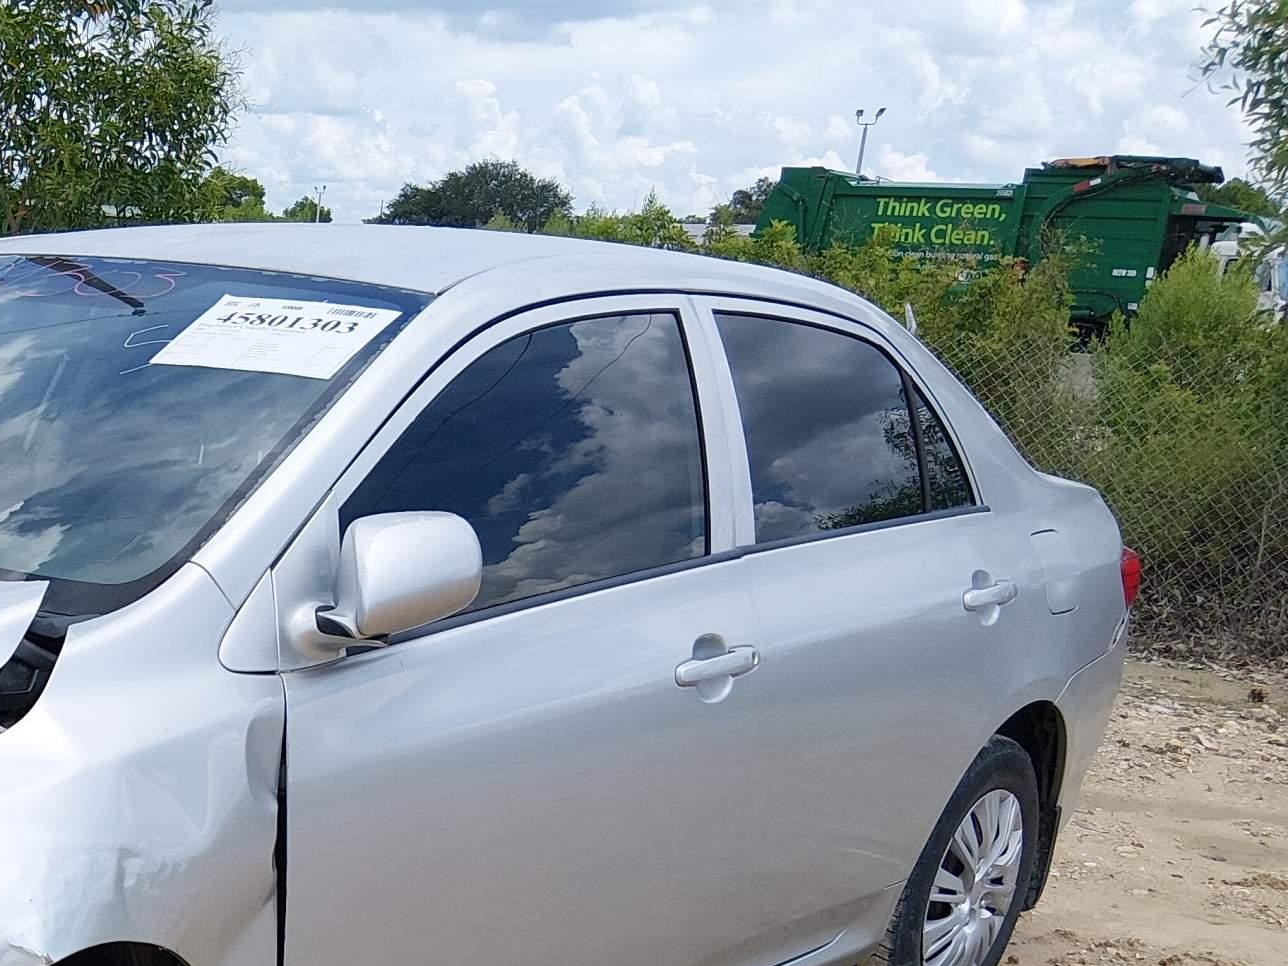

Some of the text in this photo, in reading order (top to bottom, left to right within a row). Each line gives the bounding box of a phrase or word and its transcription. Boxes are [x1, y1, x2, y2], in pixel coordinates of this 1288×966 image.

[876, 197, 1007, 221] Think Green,
[930, 224, 995, 245] Clean.
[216, 311, 360, 335] 45801303
